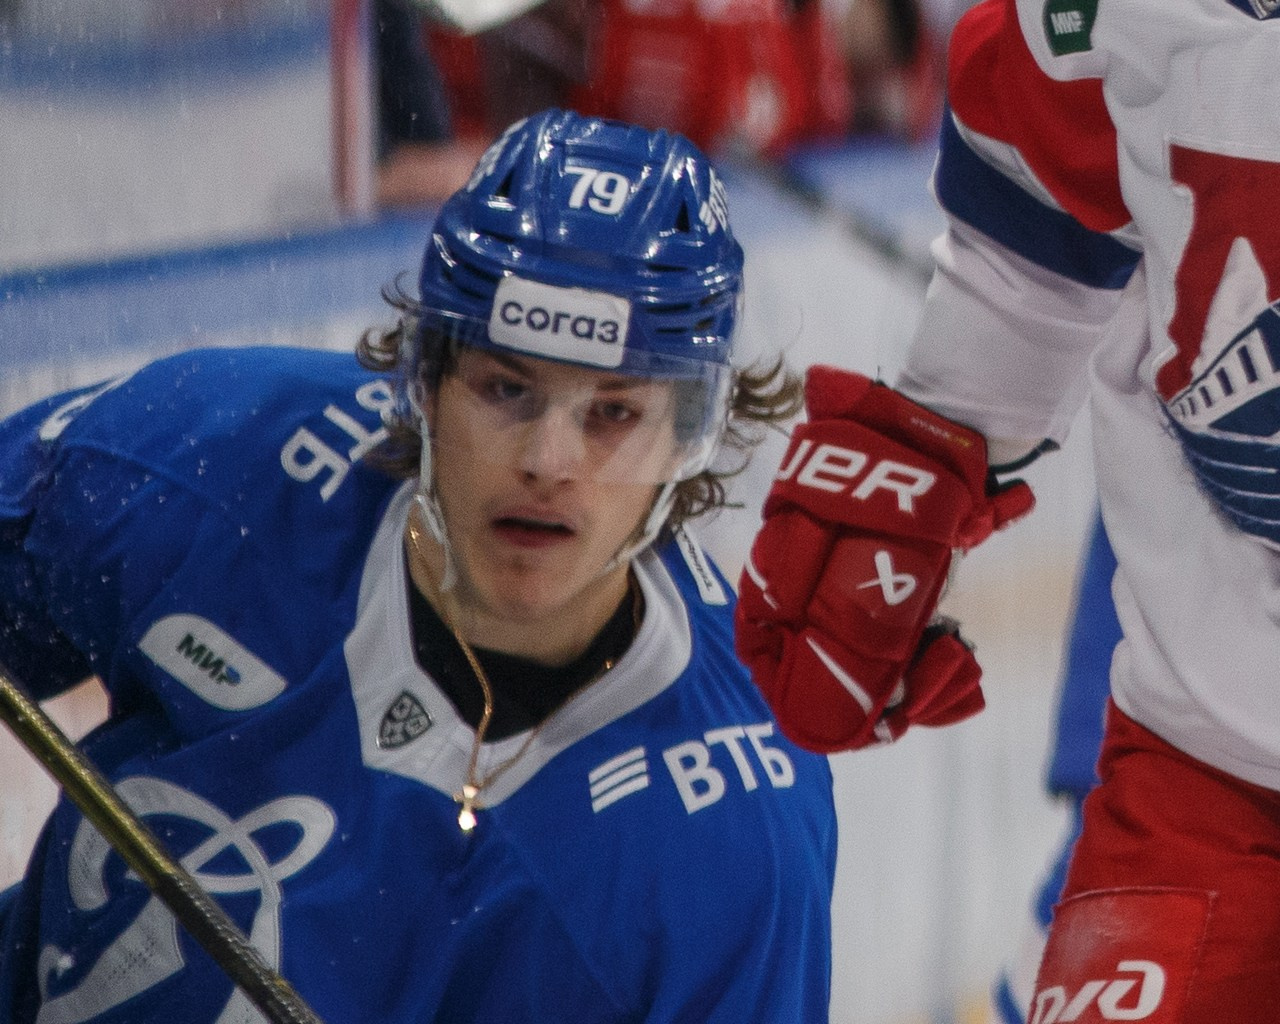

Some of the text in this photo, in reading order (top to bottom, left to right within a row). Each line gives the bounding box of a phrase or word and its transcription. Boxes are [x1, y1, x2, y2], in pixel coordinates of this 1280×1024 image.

[564, 164, 630, 216] 79
[175, 632, 242, 686] МИР
[662, 720, 796, 816] ВТБ
